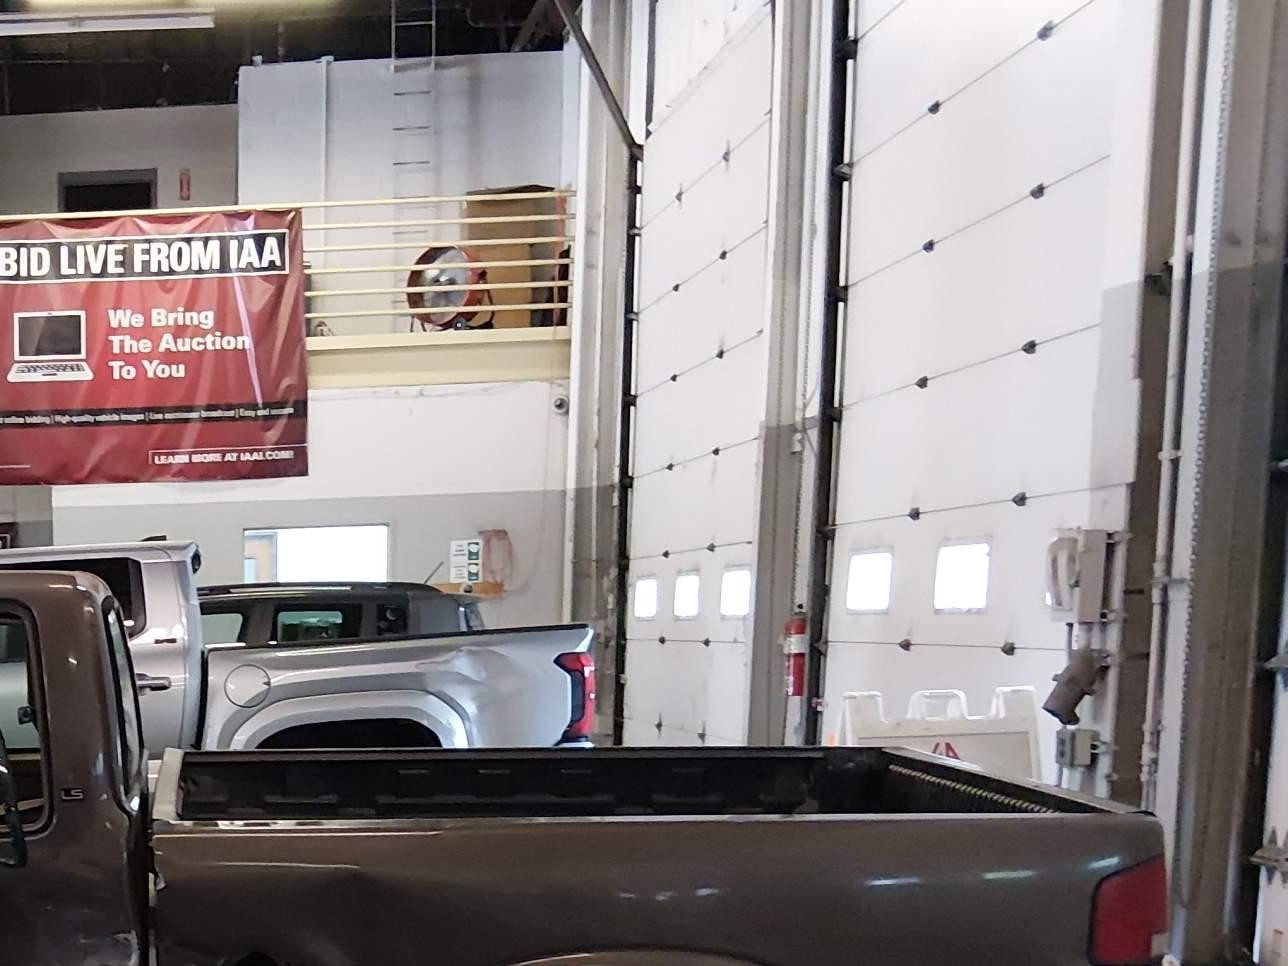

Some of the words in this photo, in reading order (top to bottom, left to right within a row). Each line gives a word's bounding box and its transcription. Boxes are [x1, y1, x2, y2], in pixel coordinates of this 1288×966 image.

[60, 244, 129, 275] LIVE
[133, 240, 221, 273] FROM
[229, 236, 282, 269] IAA
[108, 309, 144, 328] We
[151, 306, 214, 329] Bring
[108, 335, 152, 354] The
[158, 331, 250, 352] Auction
[108, 361, 137, 380] To
[141, 359, 186, 378] You
[154, 453, 190, 464] LEARN
[191, 453, 222, 463] MORE
[223, 452, 239, 462] AT
[61, 789, 83, 800] LS
